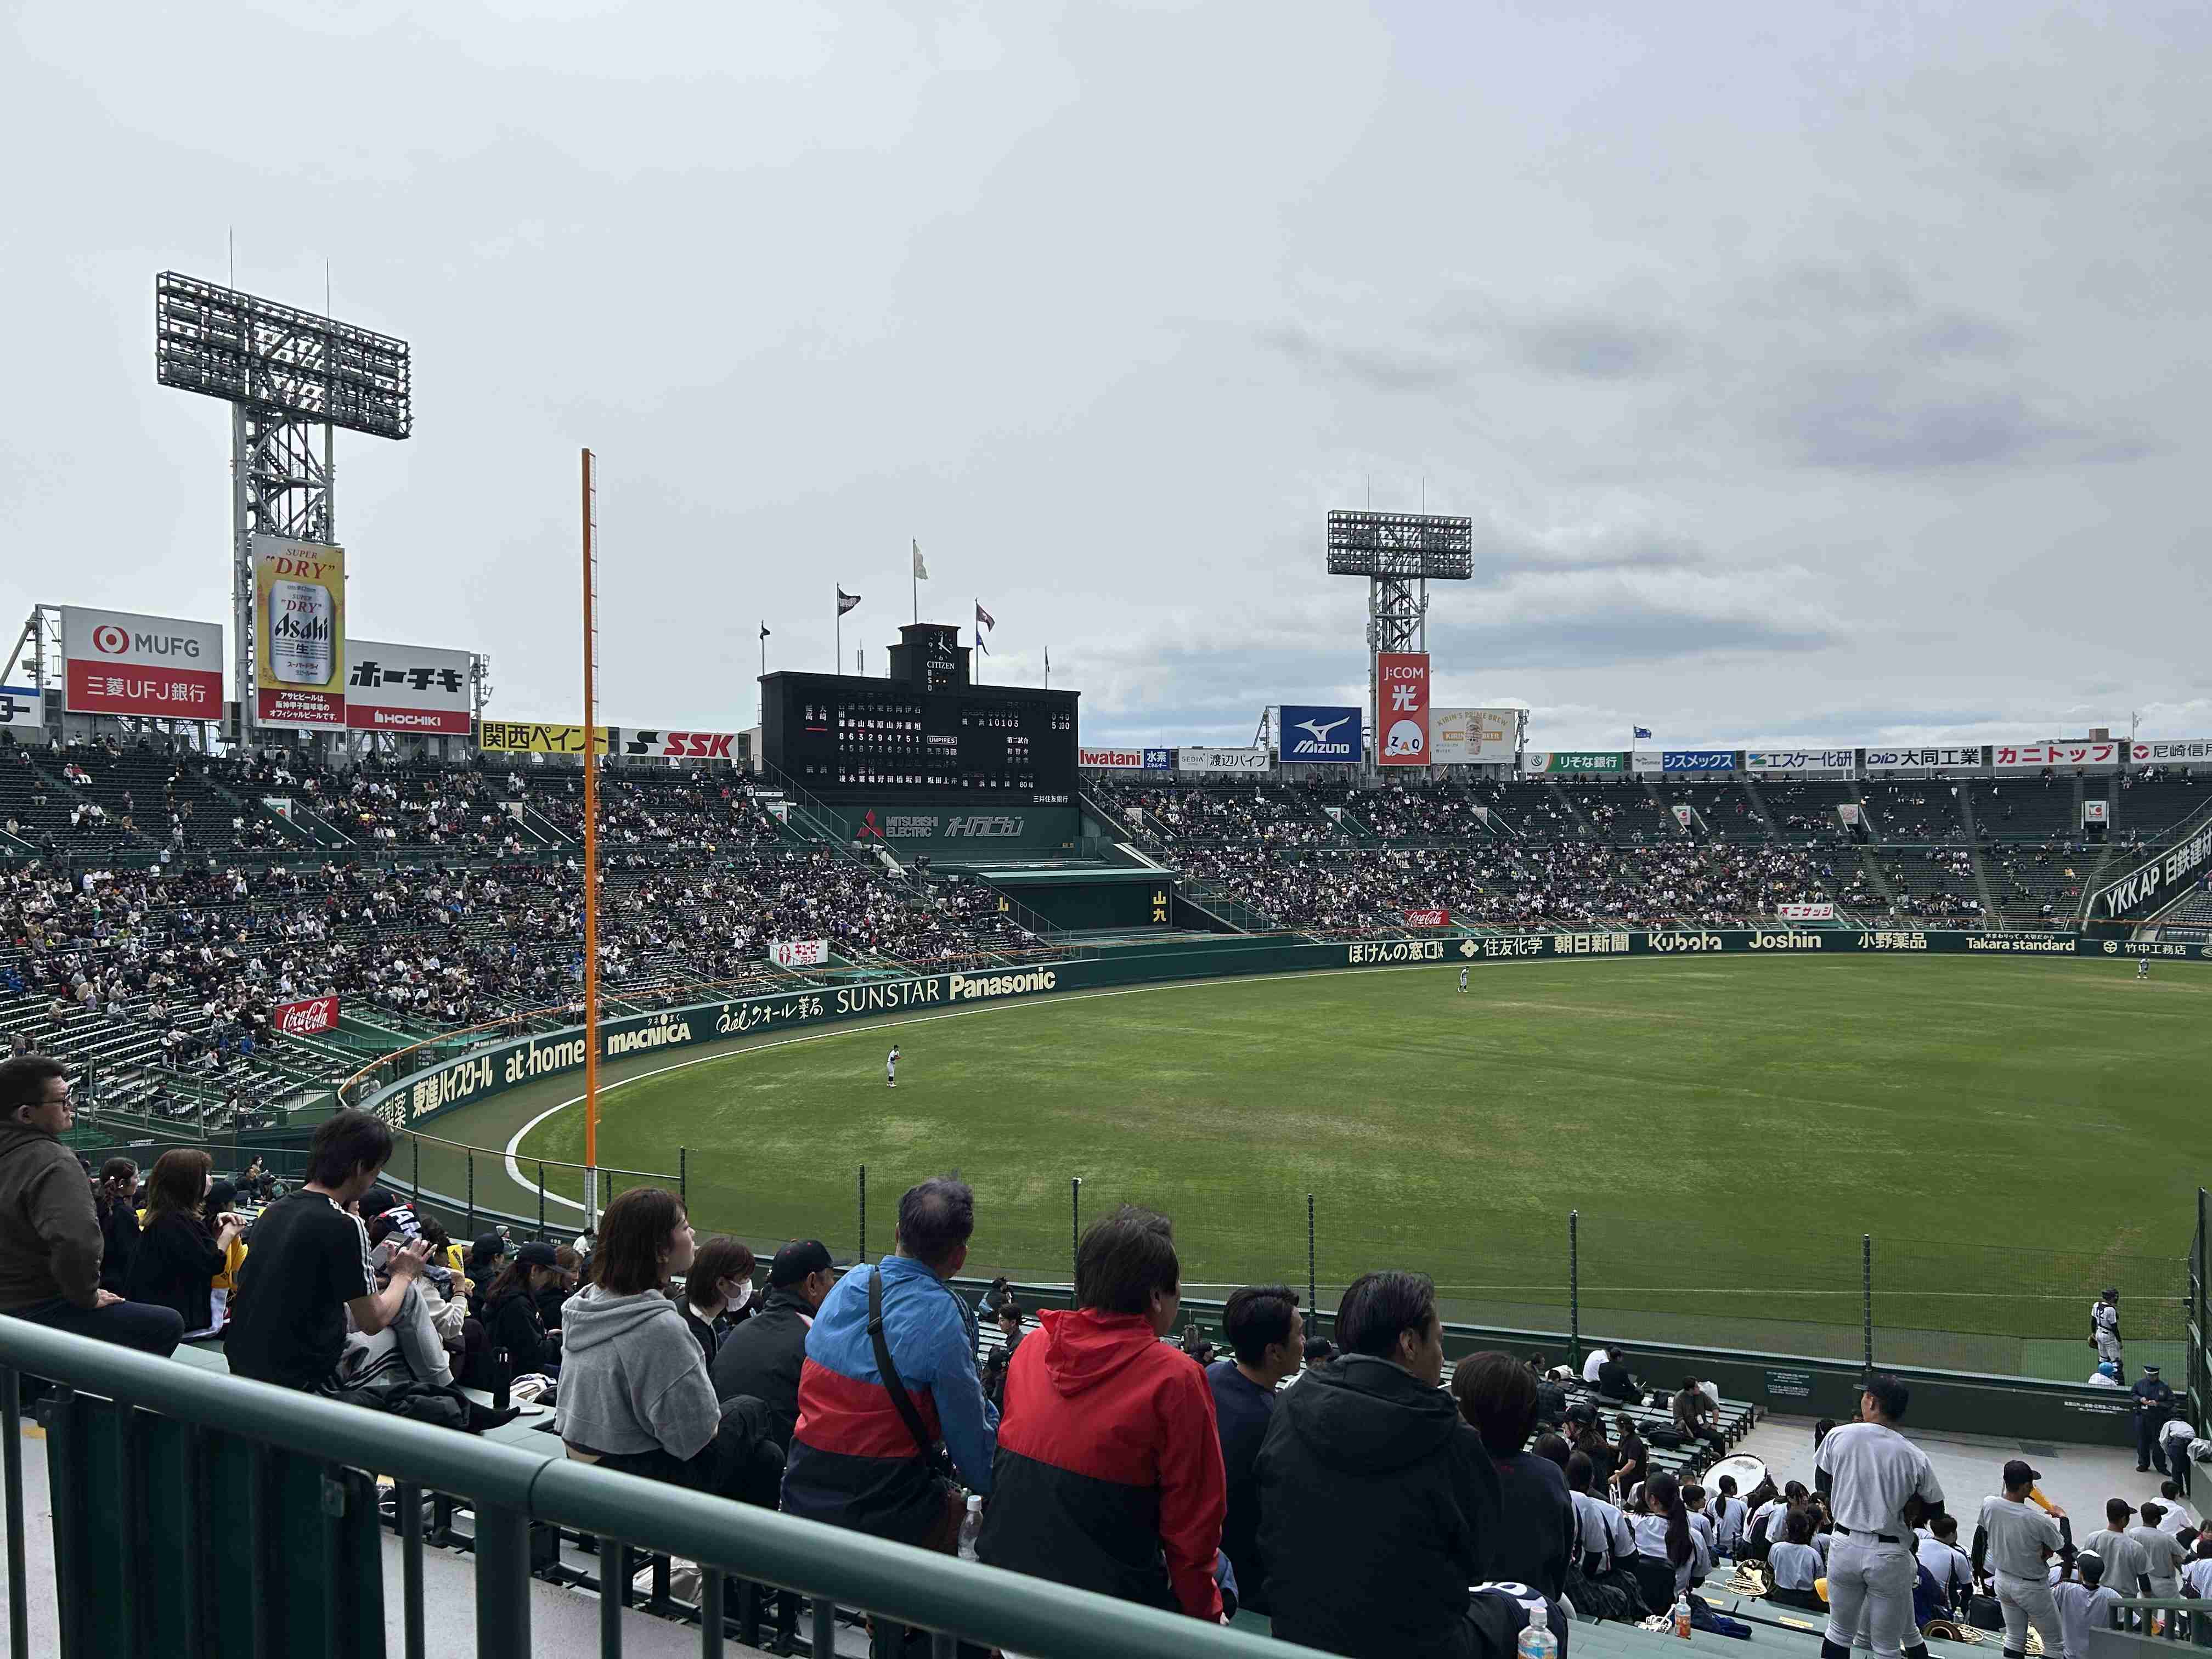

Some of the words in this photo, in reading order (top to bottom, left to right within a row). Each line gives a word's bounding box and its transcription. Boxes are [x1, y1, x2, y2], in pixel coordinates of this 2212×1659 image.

[286, 549, 317, 559] SUPER
[275, 613, 328, 641] Asahi
[136, 633, 199, 657] MUFG
[296, 644, 309, 654] 生
[927, 661, 955, 670] CITIZEN
[349, 661, 462, 692] ホーチキ
[87, 676, 206, 703] 三菱UFJ銀行
[1392, 684, 1419, 711] 光
[275, 701, 330, 712] 阪神甲子園球場の
[385, 714, 441, 726] HOCHIKI
[1488, 714, 1508, 726] BREW
[483, 723, 606, 752] 関西ペイント
[663, 732, 734, 758] SSK
[1080, 750, 1141, 766] Iwatani
[1147, 751, 1167, 763] 水素
[1210, 754, 1268, 768] 渡辺パイプ
[1560, 755, 1617, 768] りそな銀行
[1664, 754, 1734, 768] シスメックス
[1768, 751, 1852, 768] エスケー化研
[1900, 748, 1980, 766] 大同工業
[1997, 744, 2113, 764] カニトップ
[886, 816, 938, 827] MITSUBISHI
[886, 827, 932, 837] ELECTRIC
[2165, 826, 2212, 886] 日鉄建材
[2106, 877, 2138, 918] YKK
[2140, 866, 2160, 901] AP
[1153, 891, 1167, 922] 山九
[795, 941, 820, 956] キューピー
[1483, 937, 1543, 957] 住友化学
[1554, 933, 1630, 953] 朝日新聞
[1649, 933, 1722, 951] Kubota
[1748, 931, 1821, 949] Joshin
[1857, 933, 1927, 949] 小野薬品
[1966, 937, 2010, 950] Takara
[2012, 939, 2075, 951] standard
[2124, 943, 2186, 955] 竹中工務店
[1348, 941, 1440, 963] ほけんの窓口
[949, 966, 1056, 1001] Panasonic
[836, 979, 940, 1014] SUNSTAR
[505, 1059, 524, 1083] at
[526, 1040, 585, 1076] home
[413, 1056, 493, 1119] 東進ハイスクール
